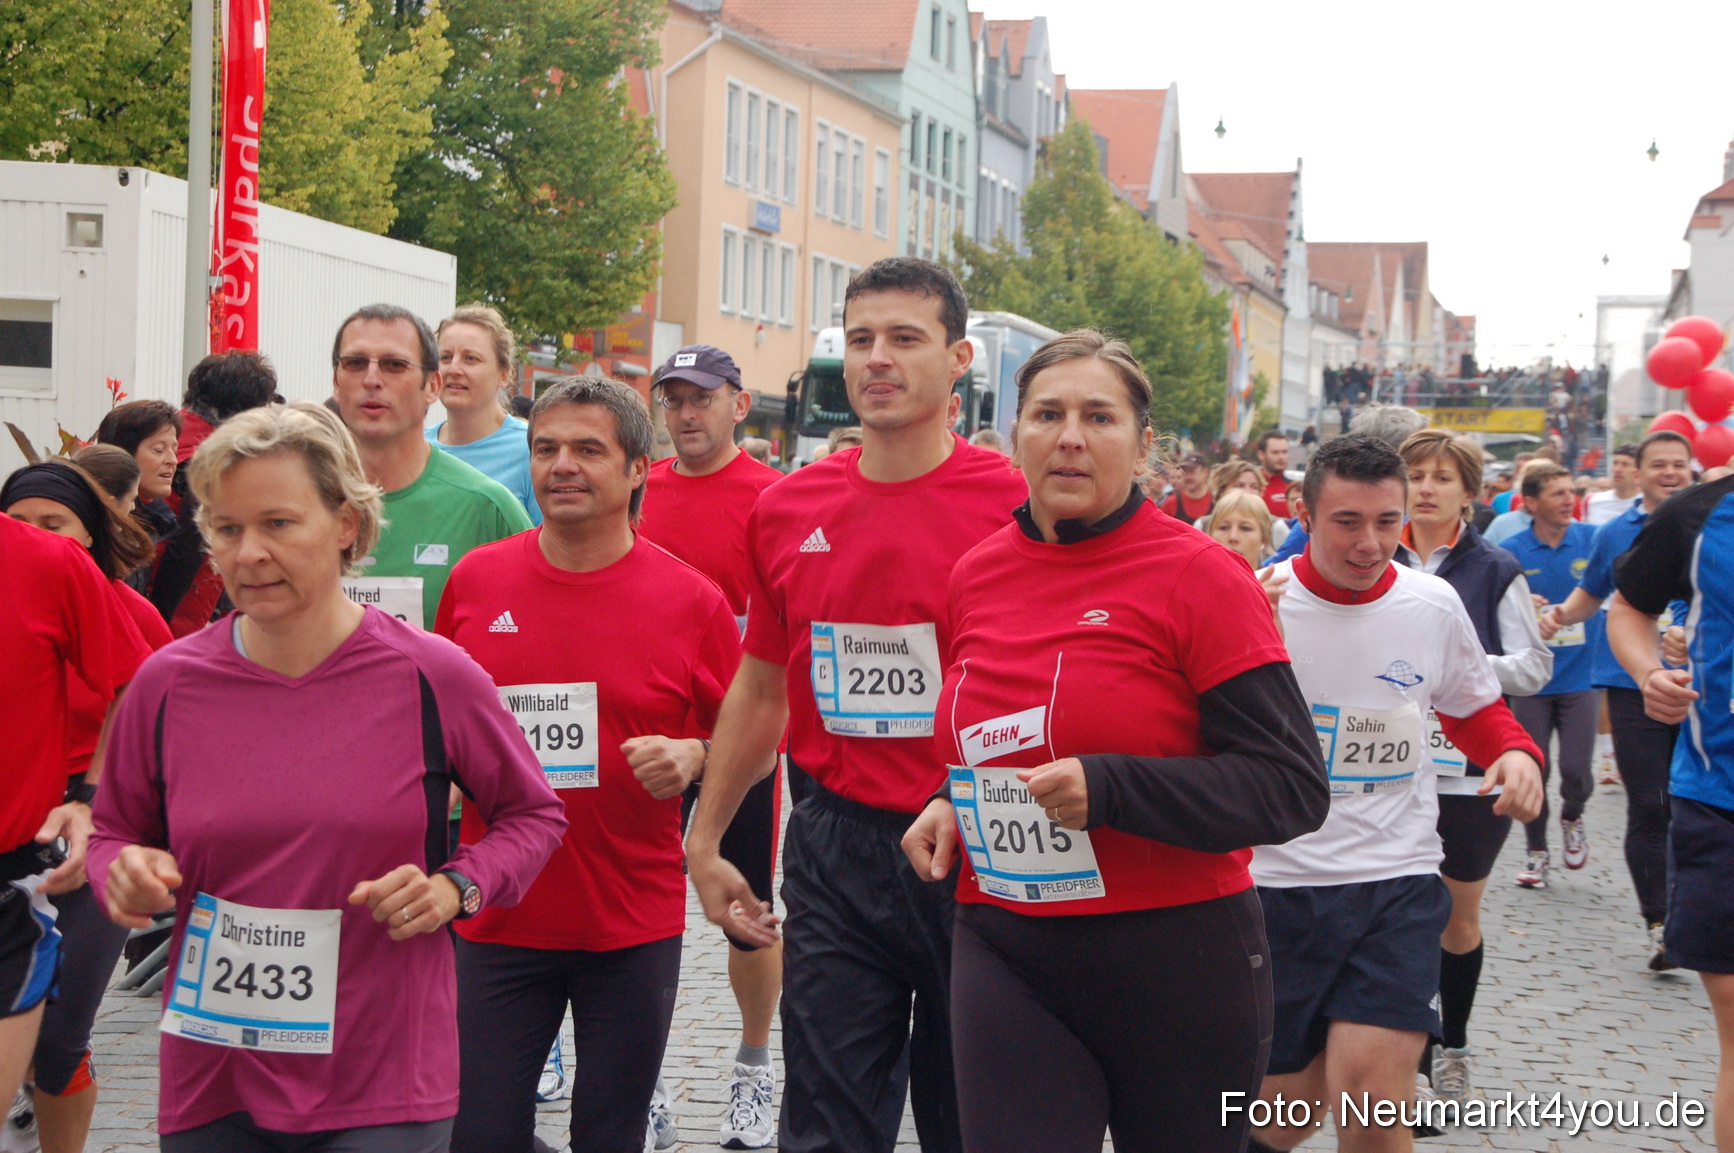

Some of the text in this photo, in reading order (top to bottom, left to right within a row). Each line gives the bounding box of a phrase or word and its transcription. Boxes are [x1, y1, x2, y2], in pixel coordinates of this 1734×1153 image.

[1434, 412, 1491, 425] START
[488, 624, 519, 633] adidas
[843, 635, 910, 656] Raimund
[819, 664, 827, 680] C
[848, 667, 926, 696] 2203
[507, 693, 569, 713] Willibald
[1346, 715, 1386, 734] Sahin
[518, 723, 584, 751] 199
[1343, 739, 1411, 764] 2120
[547, 771, 596, 782] PFLEIDERER
[962, 814, 972, 832] C
[989, 819, 1073, 855] 2015
[221, 913, 305, 947] Christine
[188, 945, 196, 964] D
[212, 956, 314, 1002] 2433
[261, 1029, 329, 1044] PFLEIDERER
